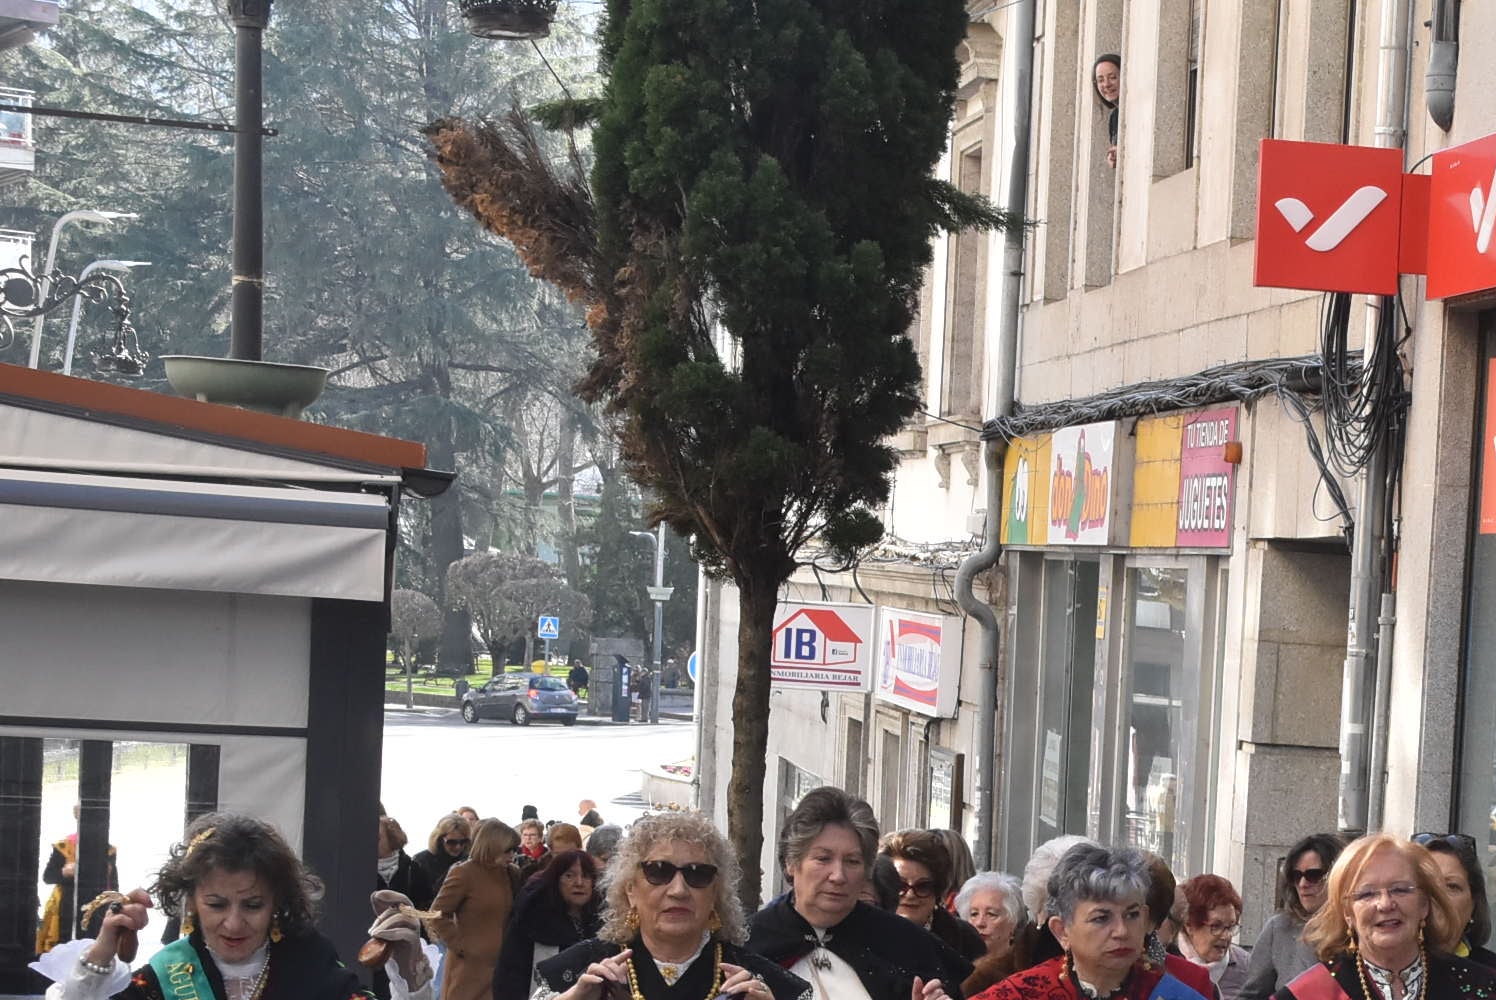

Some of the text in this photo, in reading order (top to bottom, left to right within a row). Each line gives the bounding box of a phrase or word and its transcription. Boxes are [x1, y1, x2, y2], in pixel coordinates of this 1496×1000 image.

[1187, 419, 1228, 449] TU TIENDA DE
[1179, 475, 1228, 532] JUGUETES
[783, 628, 817, 661] IB
[771, 670, 829, 680] NMOBILIARIA
